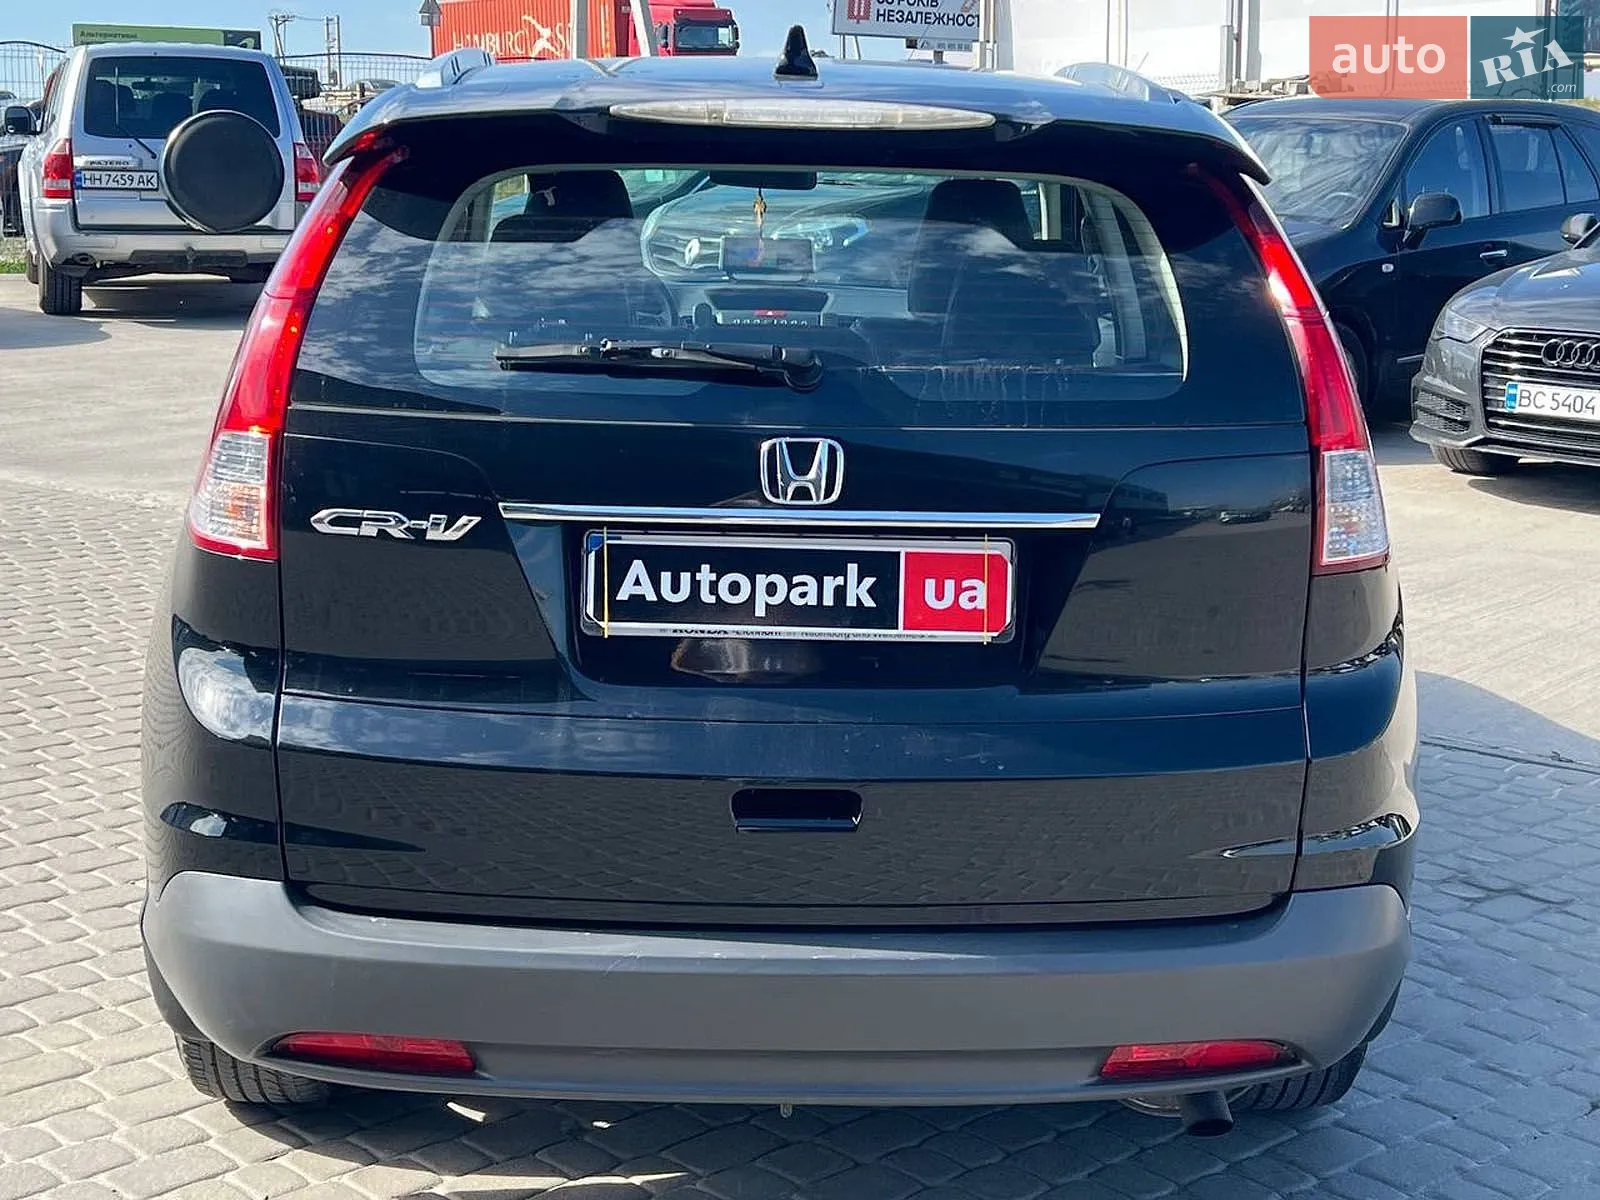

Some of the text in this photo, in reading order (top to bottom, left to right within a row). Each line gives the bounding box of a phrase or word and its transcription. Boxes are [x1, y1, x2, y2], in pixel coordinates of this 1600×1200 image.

[83, 173, 156, 188] HH 7459 AK
[1518, 389, 1597, 415] BC 5404
[310, 507, 482, 541] CR-V
[615, 559, 986, 617] Autopark ua
